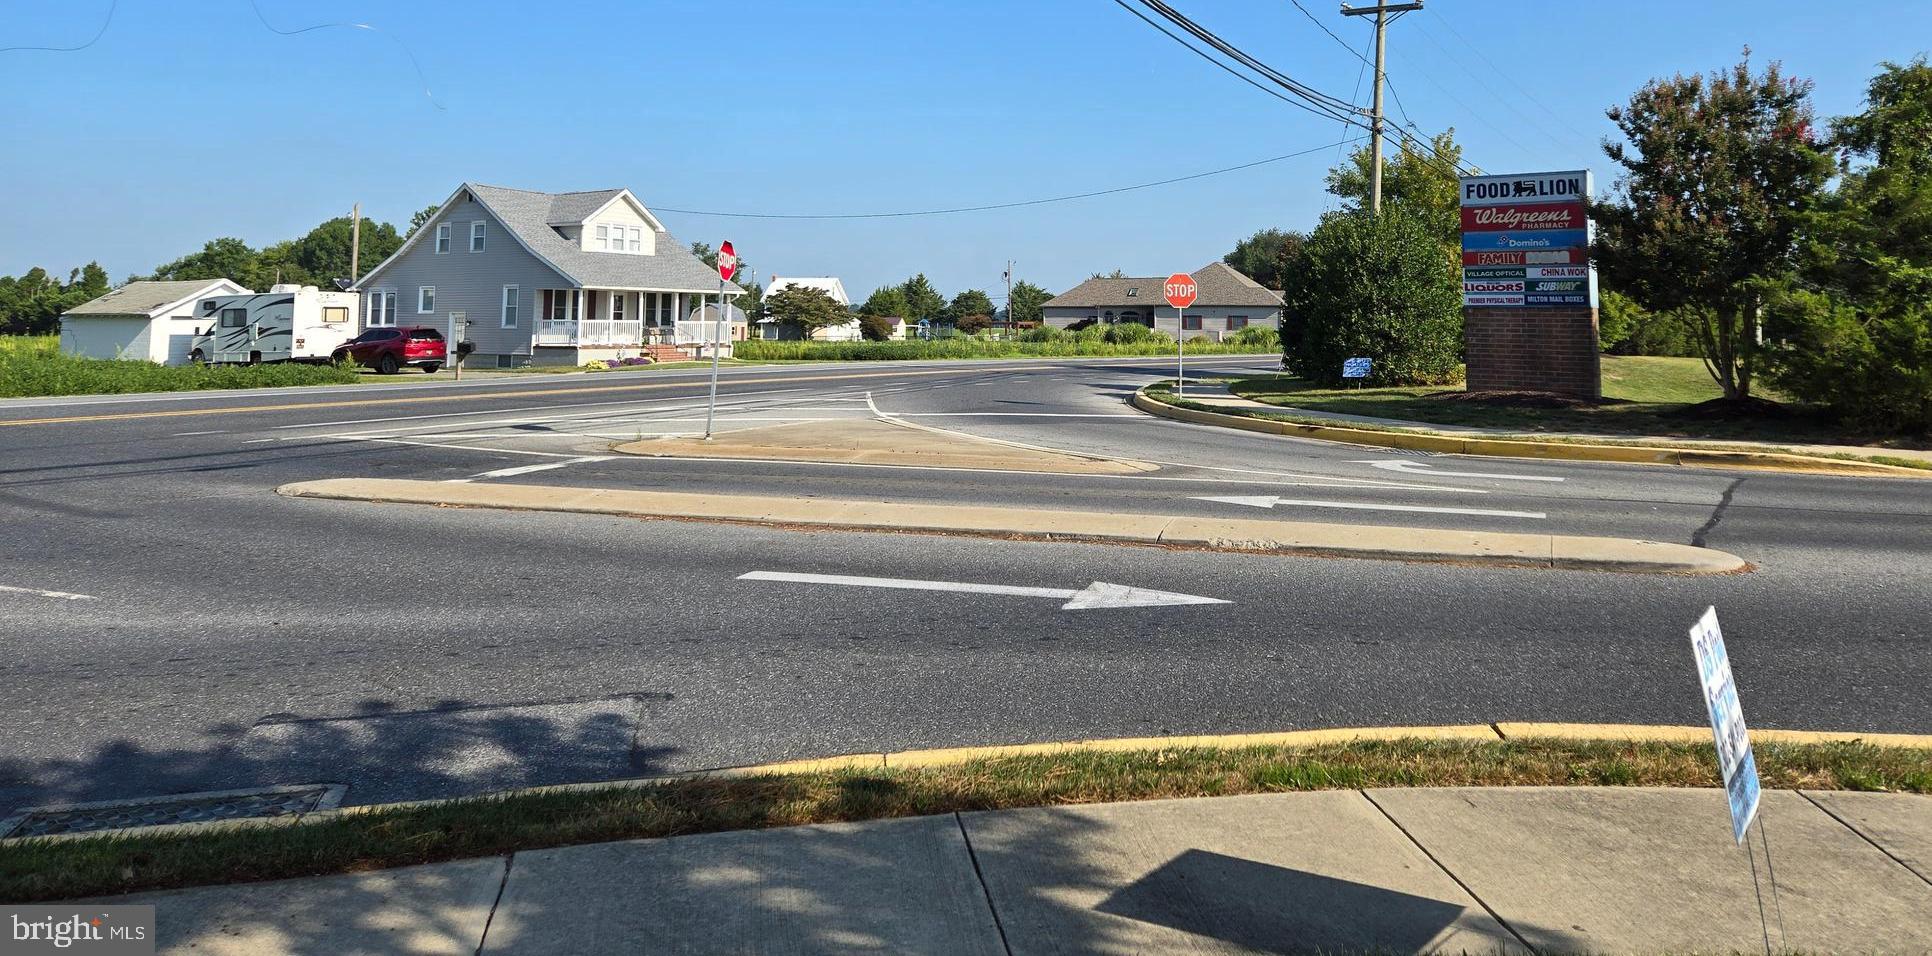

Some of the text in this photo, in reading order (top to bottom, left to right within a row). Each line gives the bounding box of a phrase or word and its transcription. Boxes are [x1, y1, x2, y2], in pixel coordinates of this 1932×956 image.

[1466, 179, 1579, 199] FOOD LION
[1473, 207, 1572, 228] Walgreens
[1522, 221, 1570, 229] PHARMACY
[1509, 238, 1550, 247] Domino's
[719, 252, 735, 269] STOP
[1479, 252, 1522, 265] FAMILY
[1495, 268, 1525, 276] OPTICAL
[1541, 267, 1587, 277] CHINA WOK
[1166, 284, 1195, 297] STOP
[1464, 283, 1524, 291] LIQUORS
[1535, 282, 1578, 291] SUBWAY
[1564, 295, 1584, 303] BOXES
